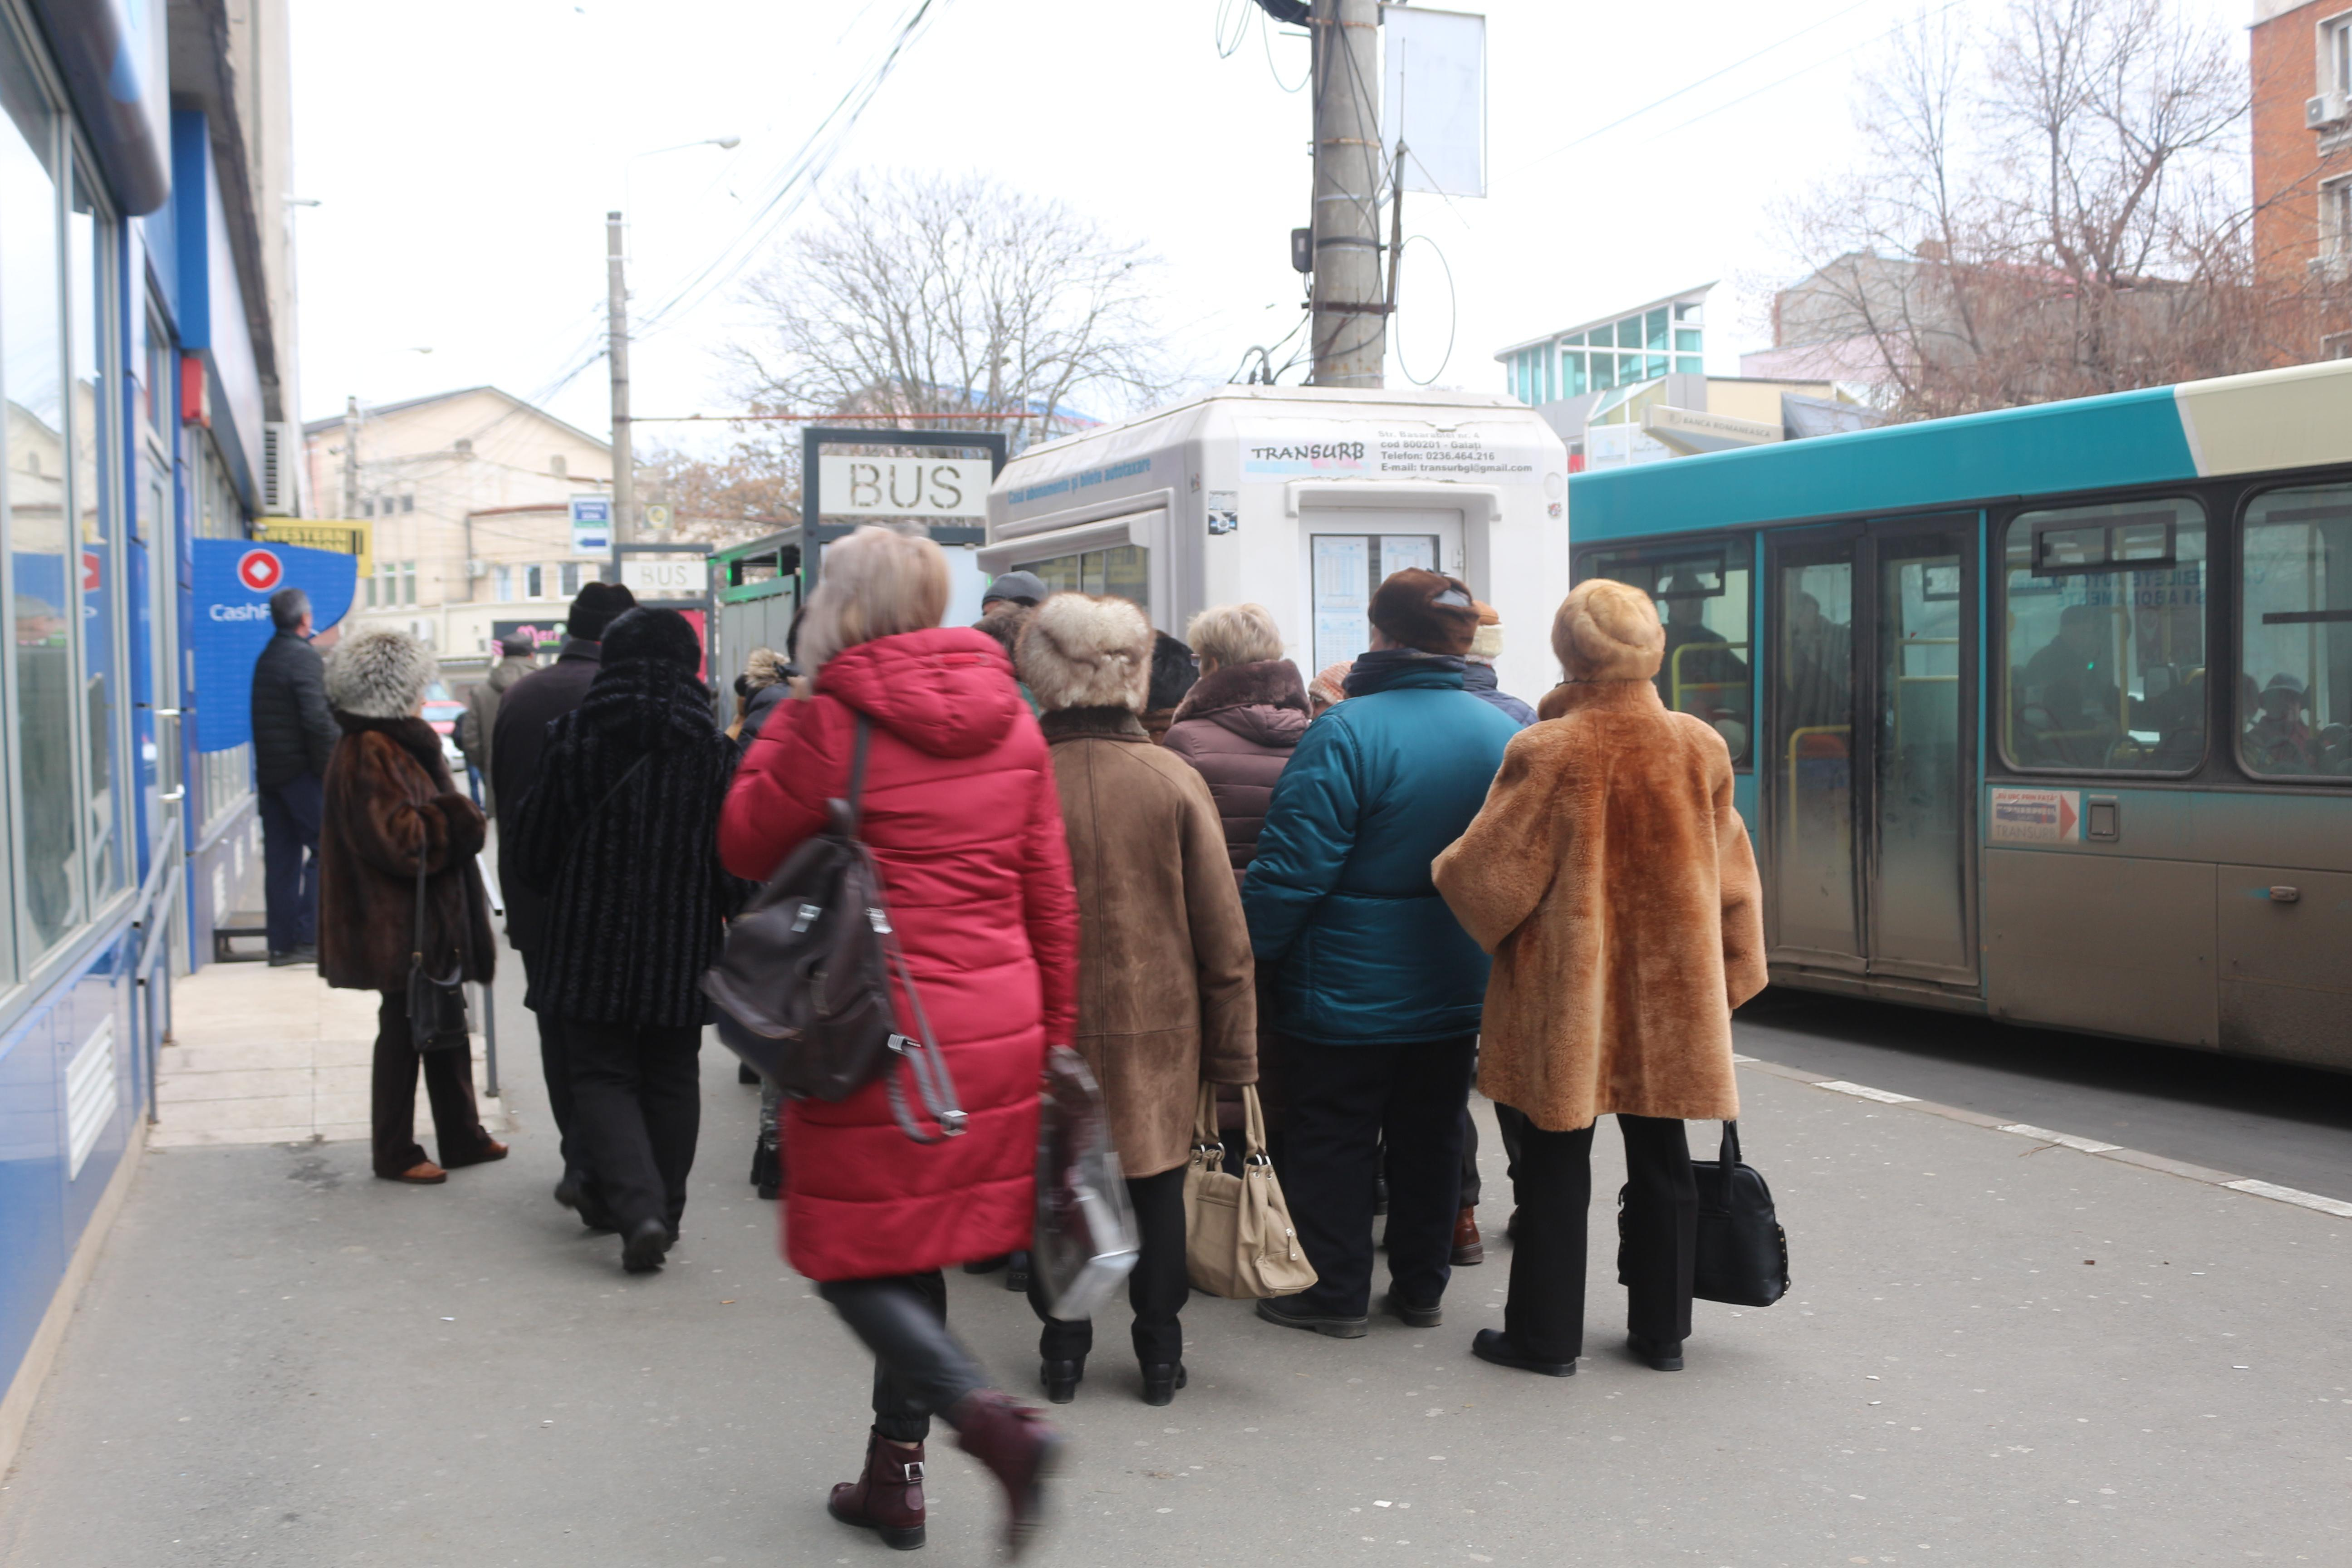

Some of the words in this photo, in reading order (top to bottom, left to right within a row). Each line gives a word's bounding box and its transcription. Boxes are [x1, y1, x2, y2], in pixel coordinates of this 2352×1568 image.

[1683, 416, 1711, 428] BANCA
[1378, 430, 1396, 438] Str.
[1251, 441, 1365, 461] TRANSURB
[1403, 441, 1441, 449] 800201
[1381, 451, 1423, 460] Telefon:
[1426, 451, 1495, 461] 0236.464.216
[1080, 470, 1102, 488] bilete
[1104, 458, 1151, 482] autotaxare
[1381, 463, 1417, 471] E-mail:
[1420, 463, 1533, 474] transurbgl@gmail.com
[850, 463, 962, 509] BUS
[640, 565, 687, 585] BUS
[1996, 824, 2057, 840] TRANSURB
